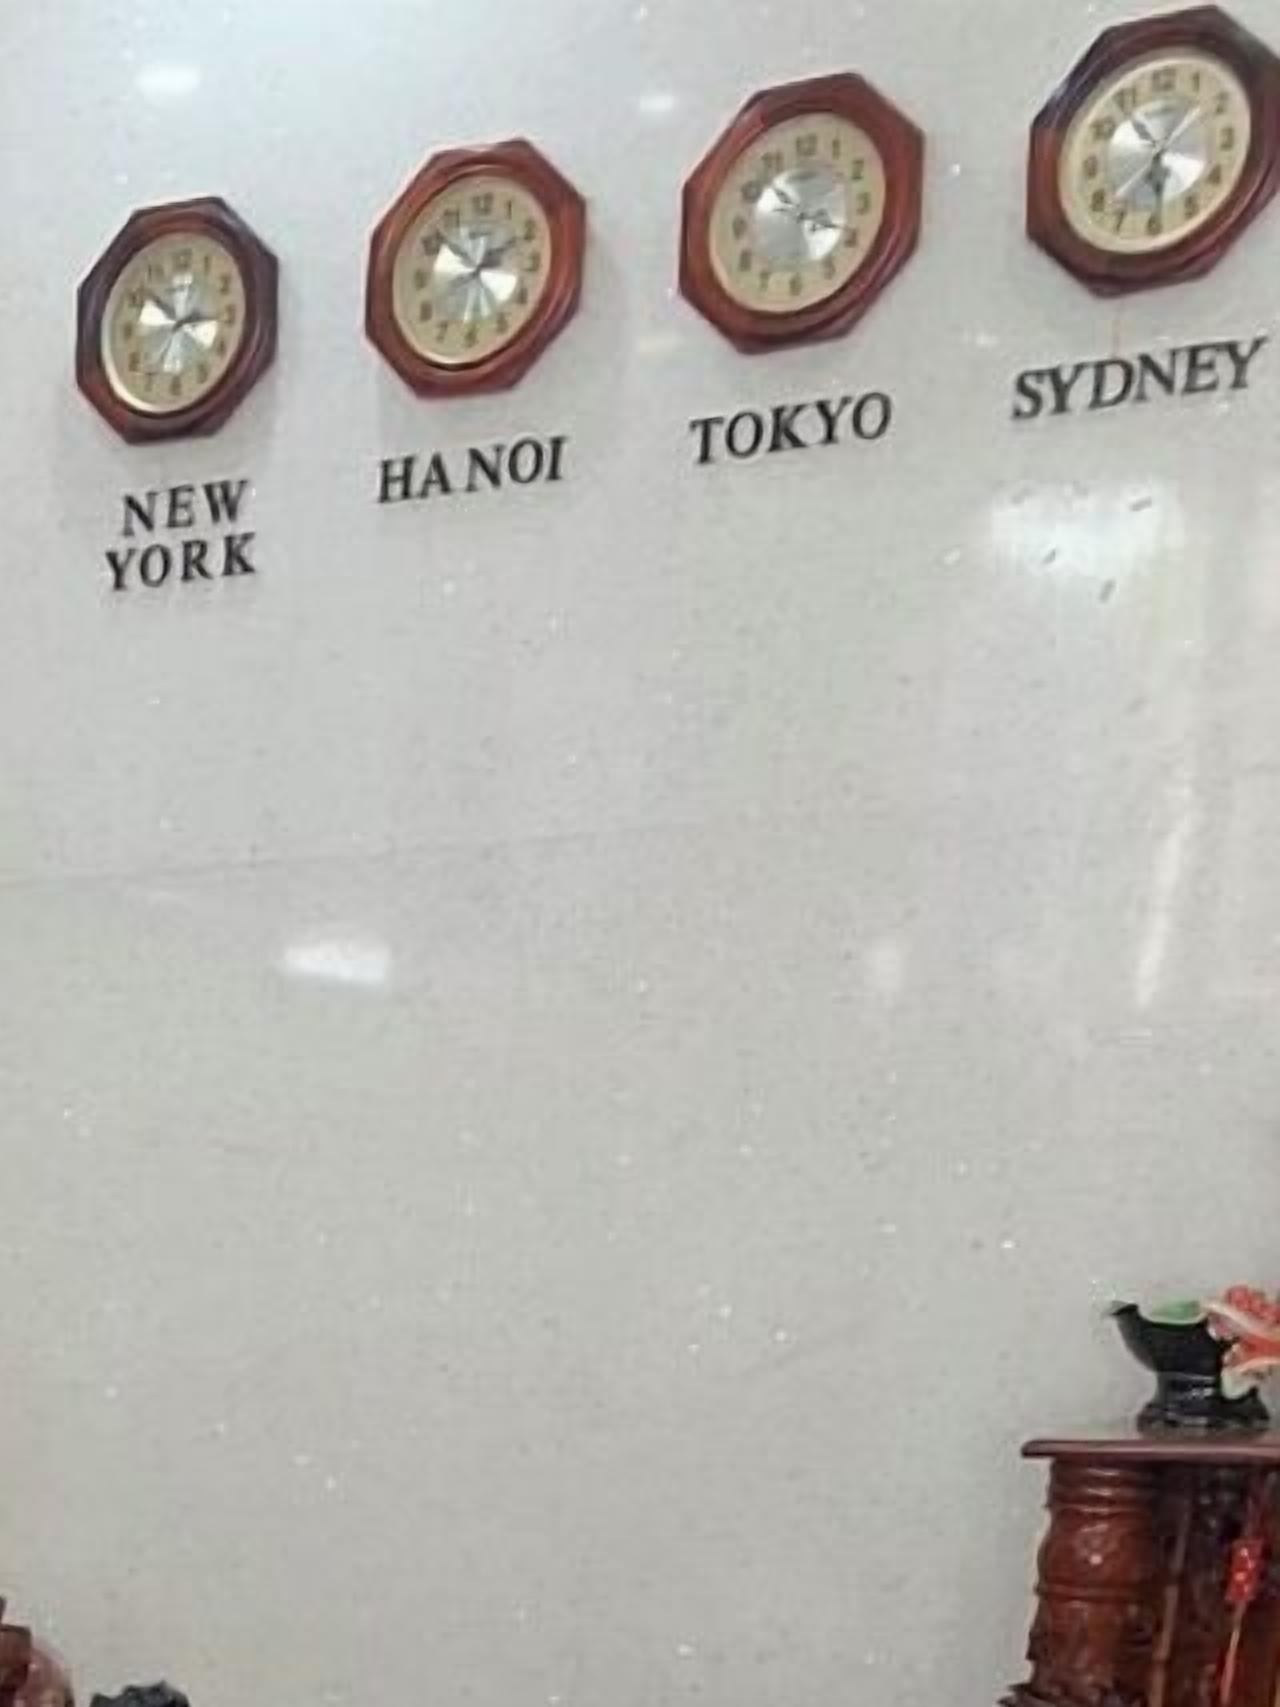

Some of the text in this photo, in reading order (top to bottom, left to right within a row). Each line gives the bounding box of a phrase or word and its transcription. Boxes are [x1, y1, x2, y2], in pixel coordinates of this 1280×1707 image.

[1011, 336, 1267, 419] SYDNEY
[689, 392, 893, 464] TOKYO
[121, 479, 249, 537] NEW
[105, 532, 256, 591] YORK
